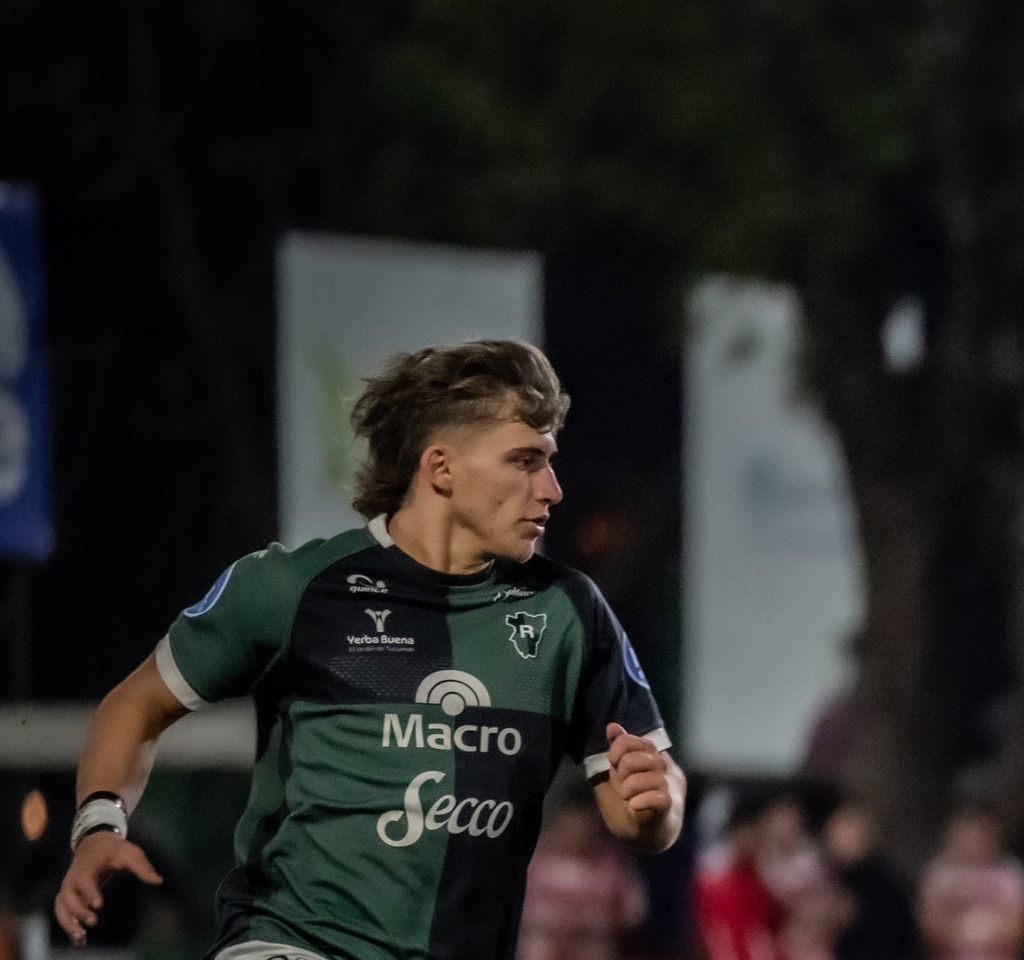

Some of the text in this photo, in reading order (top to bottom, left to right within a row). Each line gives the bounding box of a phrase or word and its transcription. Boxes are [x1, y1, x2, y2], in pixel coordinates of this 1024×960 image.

[346, 635, 415, 645] Yerba Buena
[519, 625, 535, 639] R
[382, 713, 522, 755] Macro
[376, 770, 514, 847] Secco
